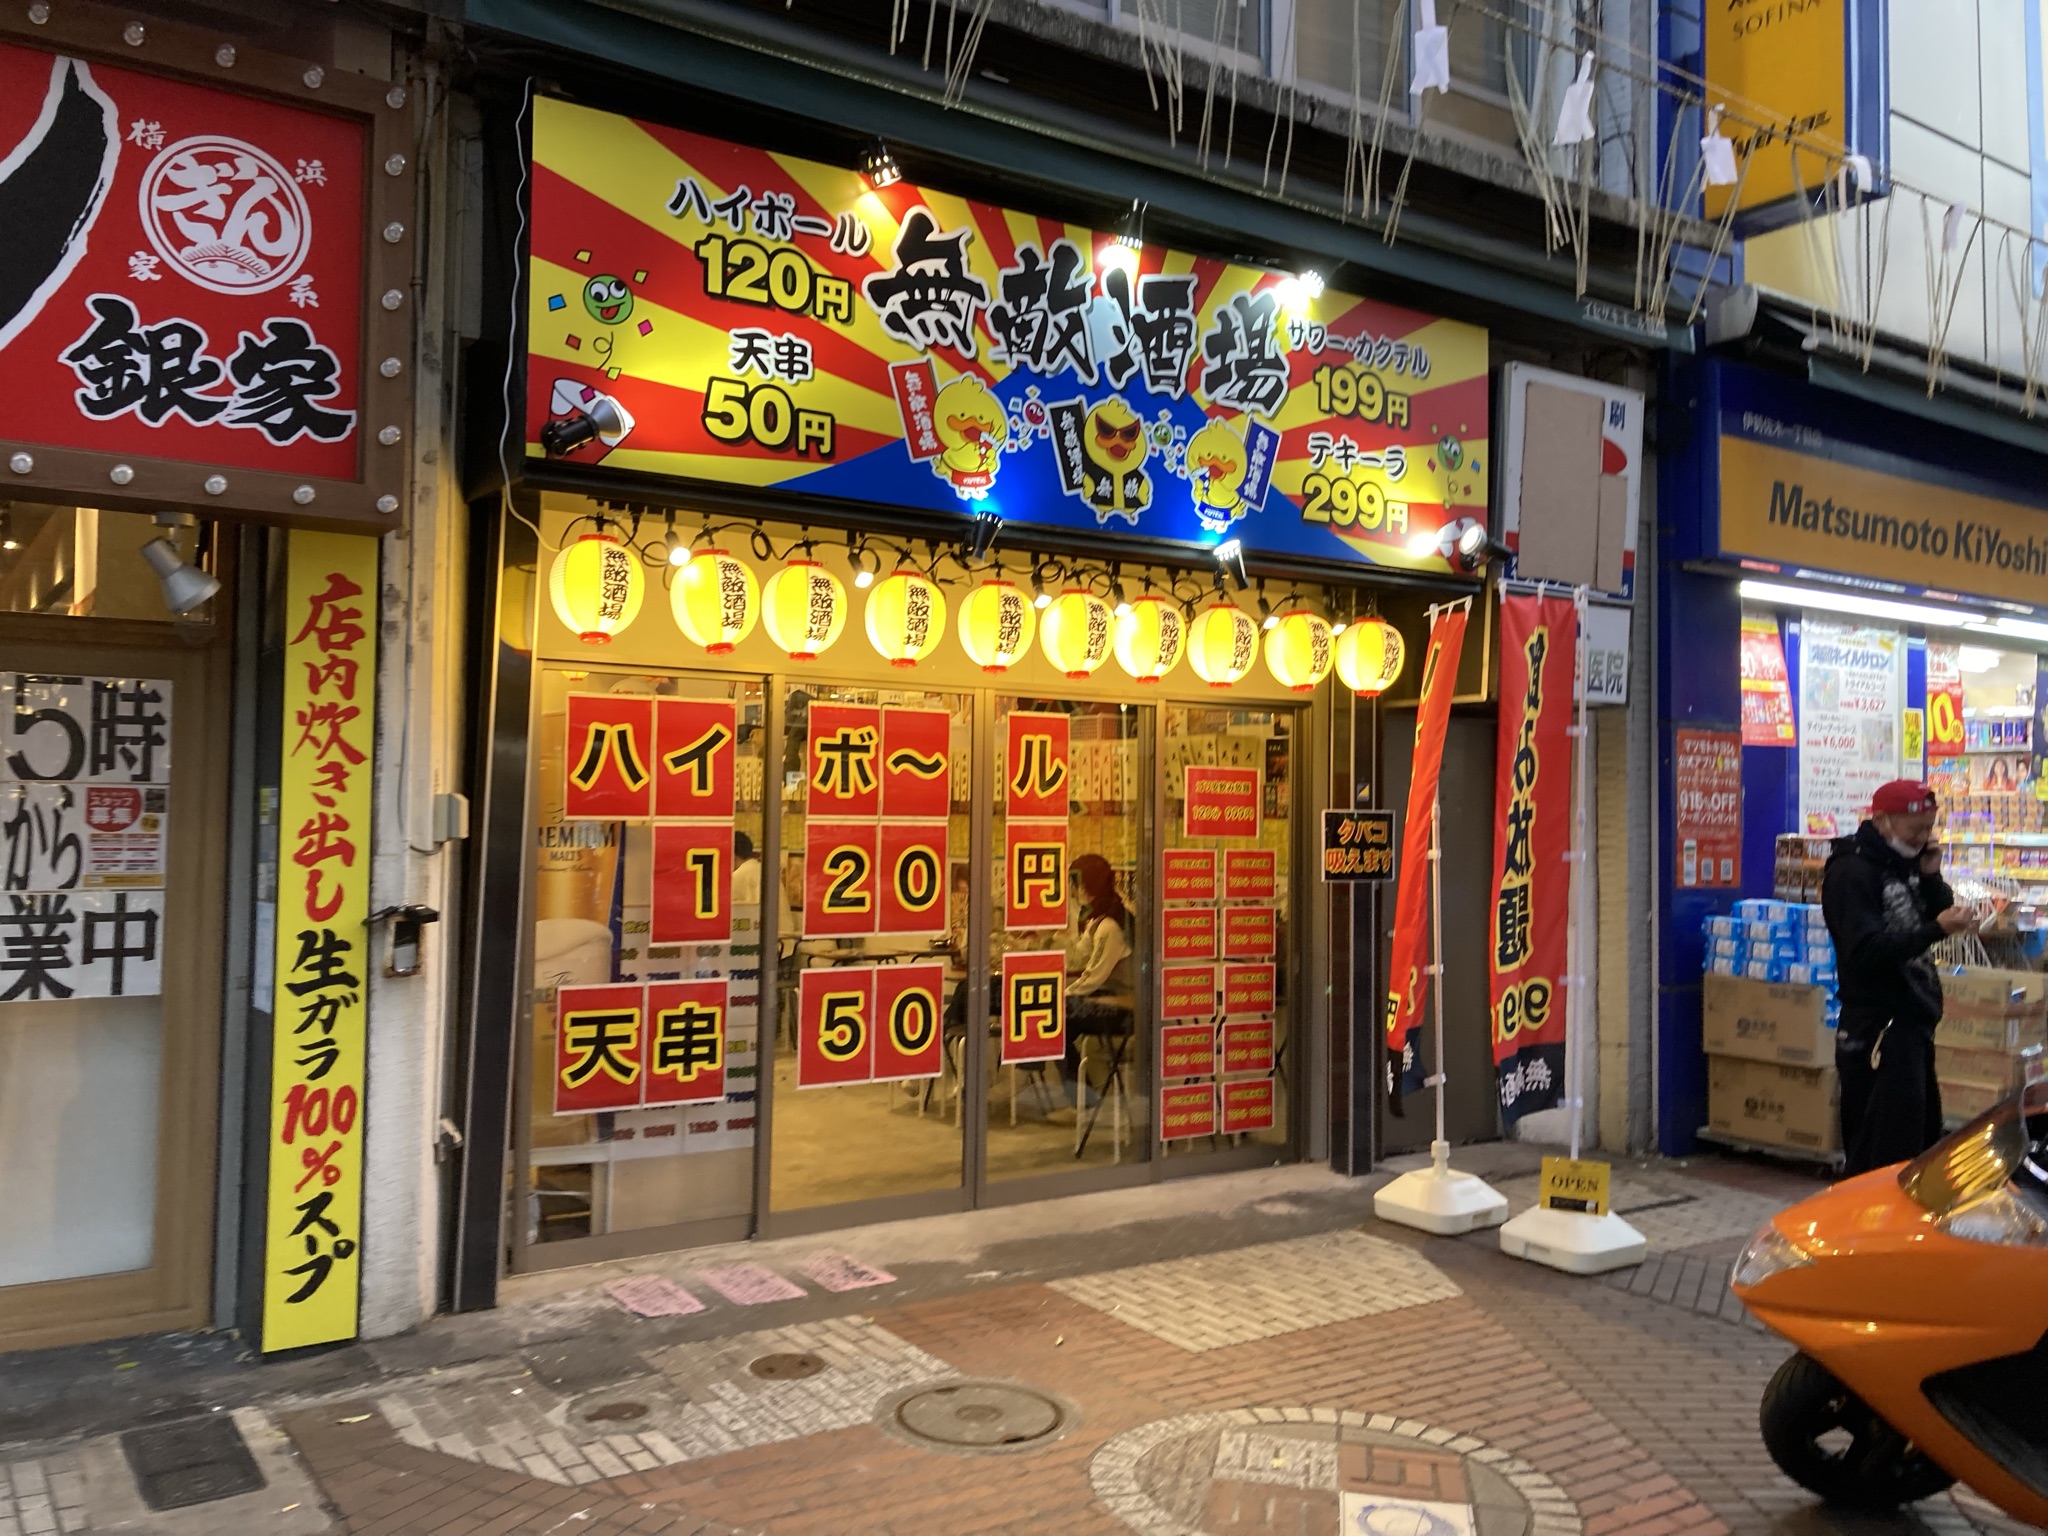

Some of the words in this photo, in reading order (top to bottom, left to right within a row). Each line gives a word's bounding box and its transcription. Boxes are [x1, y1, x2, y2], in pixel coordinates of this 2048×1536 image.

[127, 119, 167, 151] 横
[295, 159, 328, 187] 浜
[152, 154, 298, 258] ぎん
[666, 176, 871, 256] ハイボール
[128, 252, 162, 282] 家
[287, 275, 320, 308] 系
[694, 233, 855, 323] 120円
[861, 204, 1290, 418] 無敵酒場
[58, 294, 357, 446] 銀家
[728, 328, 814, 383] 天串
[1287, 318, 1432, 379] サワー・カクテル
[701, 375, 836, 457] 50円
[1313, 363, 1412, 430] 199円
[1306, 430, 1409, 481] テキーラ
[1301, 472, 1411, 536] 299円
[1768, 479, 1949, 557] Matsumoto
[597, 546, 630, 621] 無敵酒場
[717, 560, 747, 630] 無敵酒場
[805, 574, 835, 642] 無敵酒場
[903, 584, 929, 648] 無敵酒場
[996, 594, 1023, 655] 無敵酒場
[1325, 847, 1393, 874] 吸えます
[1337, 818, 1388, 845] タバコ
[561, 1001, 723, 1091] 天串
[1551, 1175, 1599, 1192] OPEN
